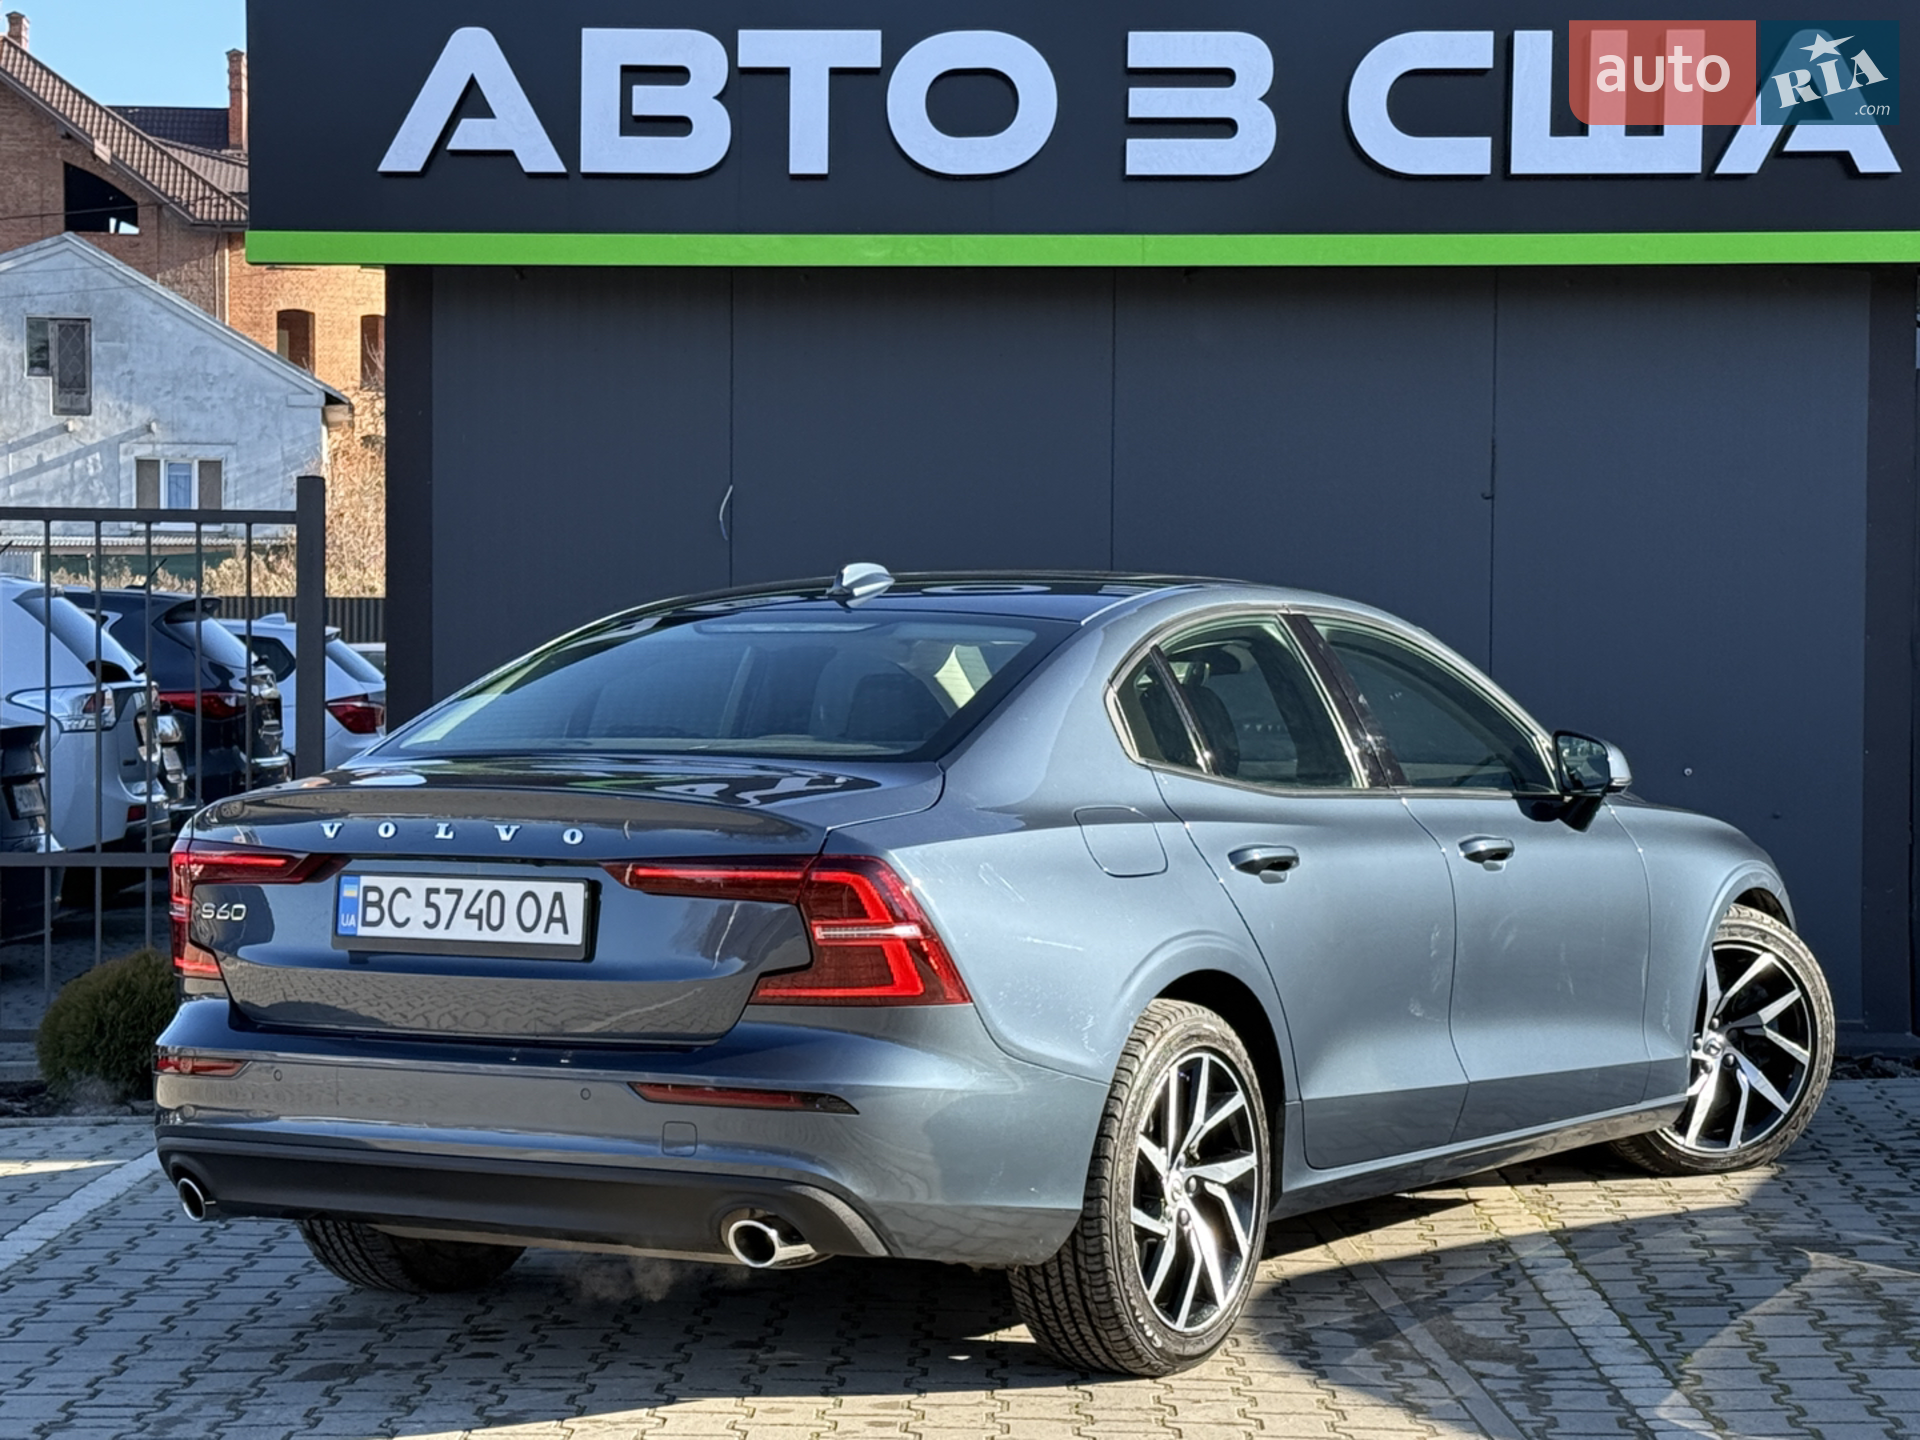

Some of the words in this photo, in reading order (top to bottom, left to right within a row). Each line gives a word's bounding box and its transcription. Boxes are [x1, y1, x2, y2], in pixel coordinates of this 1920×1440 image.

[377, 26, 1058, 176] АВТО
[1125, 29, 1277, 176] З
[1347, 28, 1902, 175] США
[321, 821, 584, 845] VOLVO
[201, 903, 247, 921] S60
[340, 913, 356, 928] UA
[361, 885, 412, 929] BC
[423, 887, 505, 932] 5740
[516, 890, 569, 935] OA
